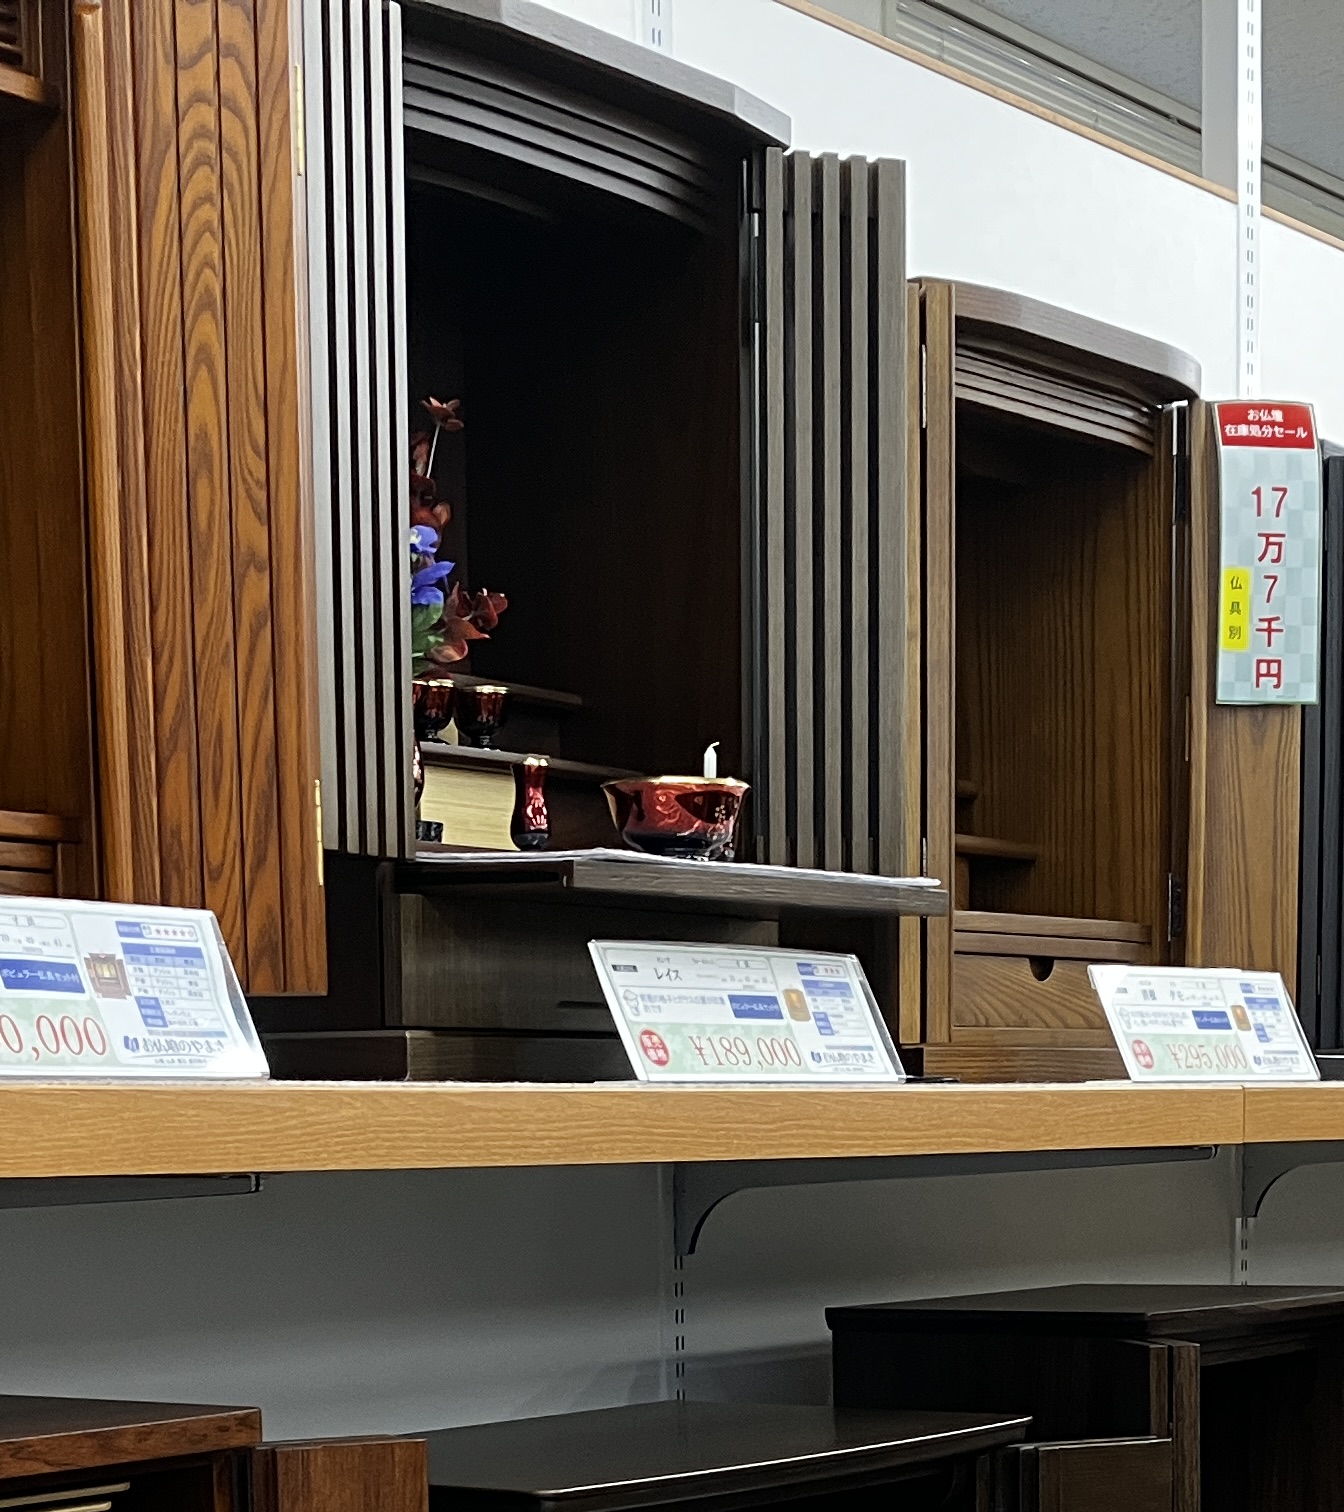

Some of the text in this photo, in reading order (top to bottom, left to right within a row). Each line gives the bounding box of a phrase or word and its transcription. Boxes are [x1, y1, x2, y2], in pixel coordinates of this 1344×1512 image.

[1224, 423, 1308, 439] 在庫処分セール
[1250, 485, 1289, 690] 17万7千円
[1227, 575, 1244, 641] 仏具別
[653, 966, 683, 982] レイス
[688, 1035, 803, 1070] ¥189,000
